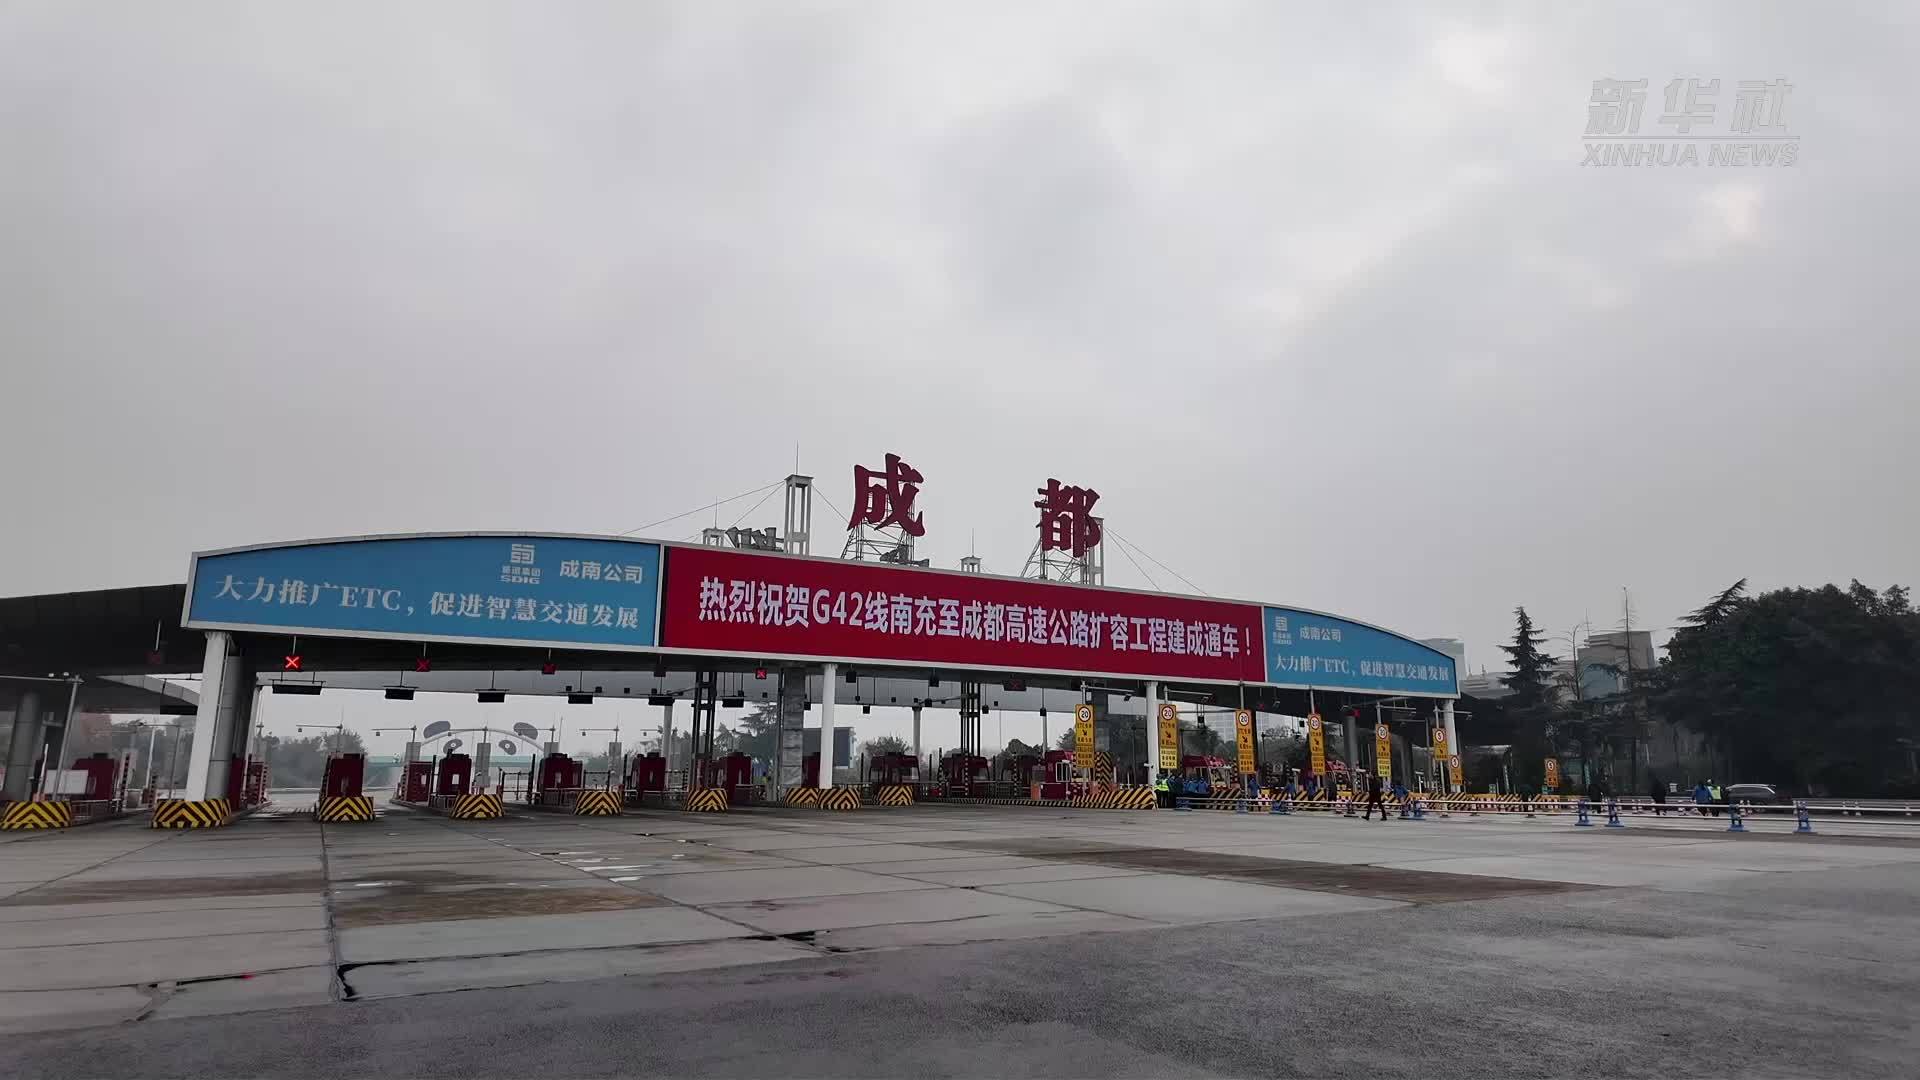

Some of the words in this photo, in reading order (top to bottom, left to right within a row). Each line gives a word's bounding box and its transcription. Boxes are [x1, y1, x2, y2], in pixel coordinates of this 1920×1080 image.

[847, 453, 1100, 558] 成都
[500, 575, 540, 584] SDIG
[559, 559, 644, 584] 成南公司
[1300, 626, 1342, 643] 成南公司
